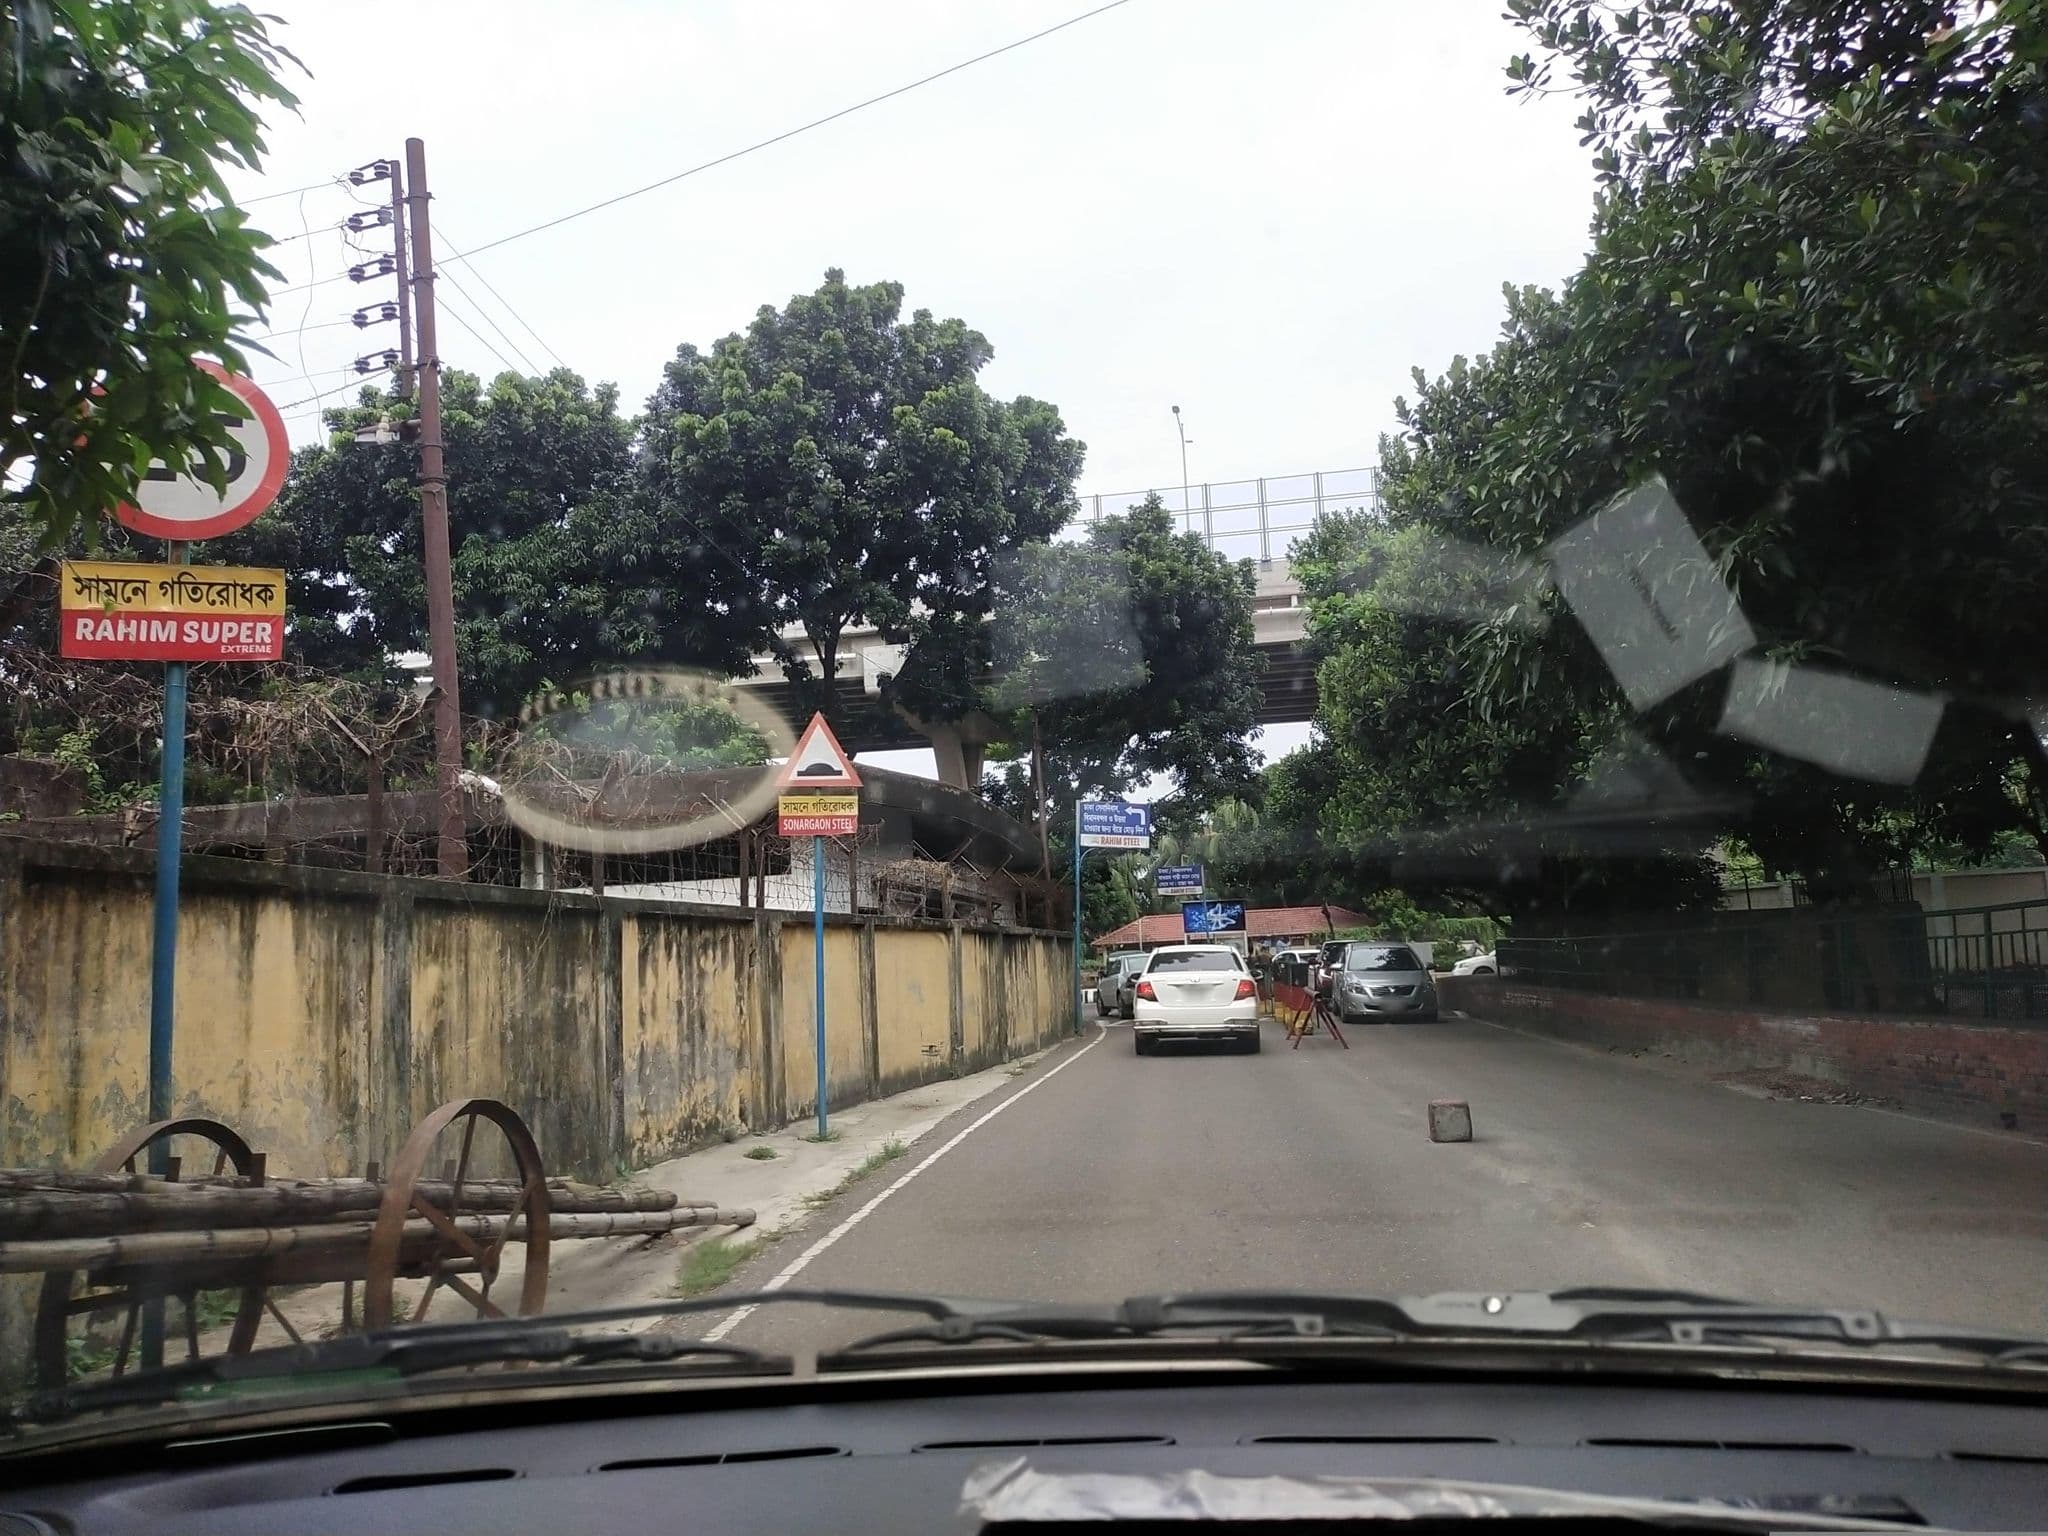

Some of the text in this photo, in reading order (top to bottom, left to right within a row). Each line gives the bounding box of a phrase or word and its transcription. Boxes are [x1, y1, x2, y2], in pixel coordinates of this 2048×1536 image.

[72, 571, 277, 608] সামনে গতিরোধক
[75, 617, 272, 644] RAHIM SUPER
[220, 644, 272, 654] EXTREME
[783, 798, 855, 813] সামনে গতিরোধক
[783, 817, 853, 831] SONARGAON STEEL
[1100, 836, 1141, 846] RAHIM STEEL
